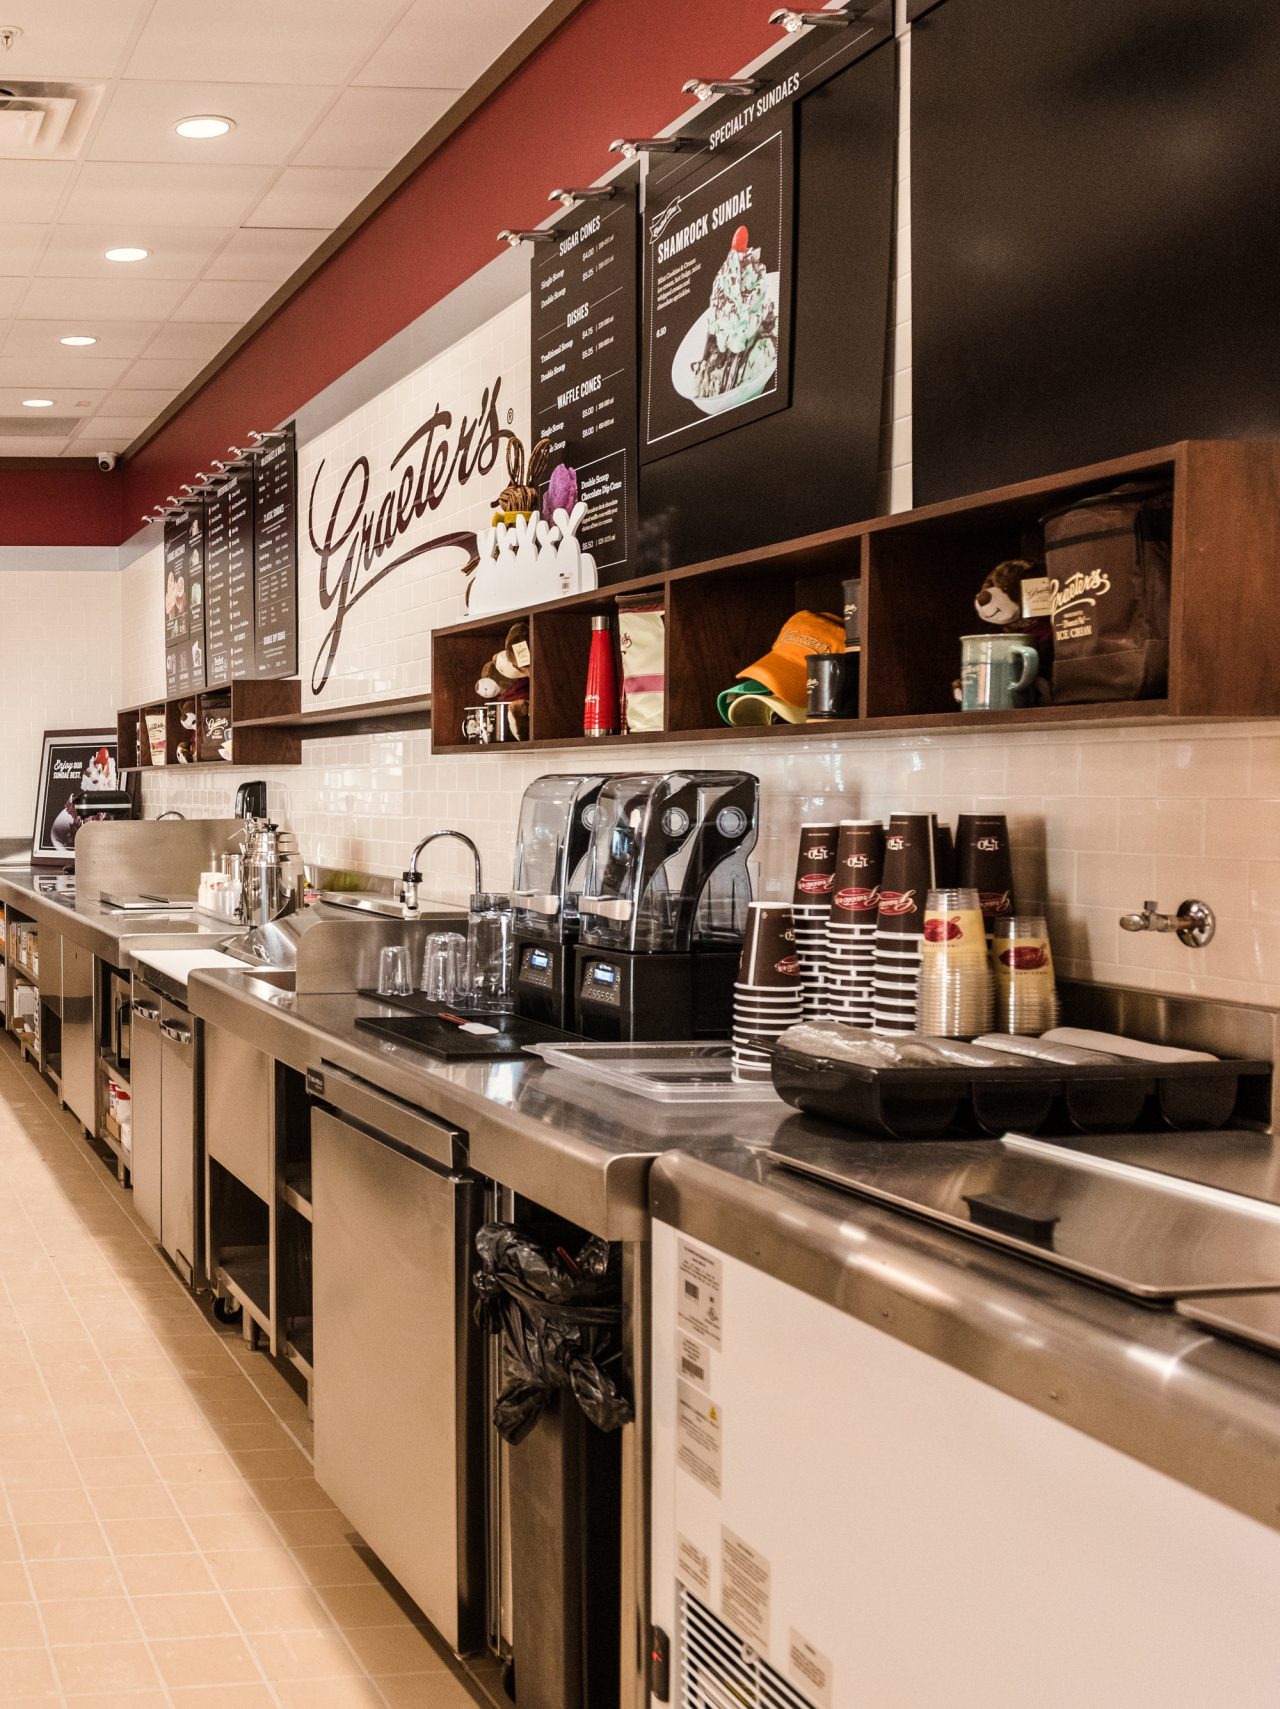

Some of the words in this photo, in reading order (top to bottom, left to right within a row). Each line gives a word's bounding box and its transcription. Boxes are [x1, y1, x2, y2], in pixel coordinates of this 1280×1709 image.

[708, 104, 756, 151] SPECIALTY
[756, 72, 801, 117] SUNDAES
[657, 212, 709, 265] SHAMROCK
[711, 184, 753, 230] SUNDAE
[559, 232, 580, 257] SUGAR
[580, 215, 601, 243] CONES
[566, 302, 589, 328] DISHES
[557, 387, 580, 410] WAFFLE
[580, 374, 602, 398] CONES
[595, 473, 609, 485] Scoop
[309, 375, 517, 695] Graeter's
[1056, 630, 1070, 641] ICE
[53, 759, 74, 772] Enjoy
[53, 771, 70, 779] SUNDAE
[976, 837, 1000, 851] 150
[807, 846, 829, 860] 150
[846, 856, 869, 868] 150
